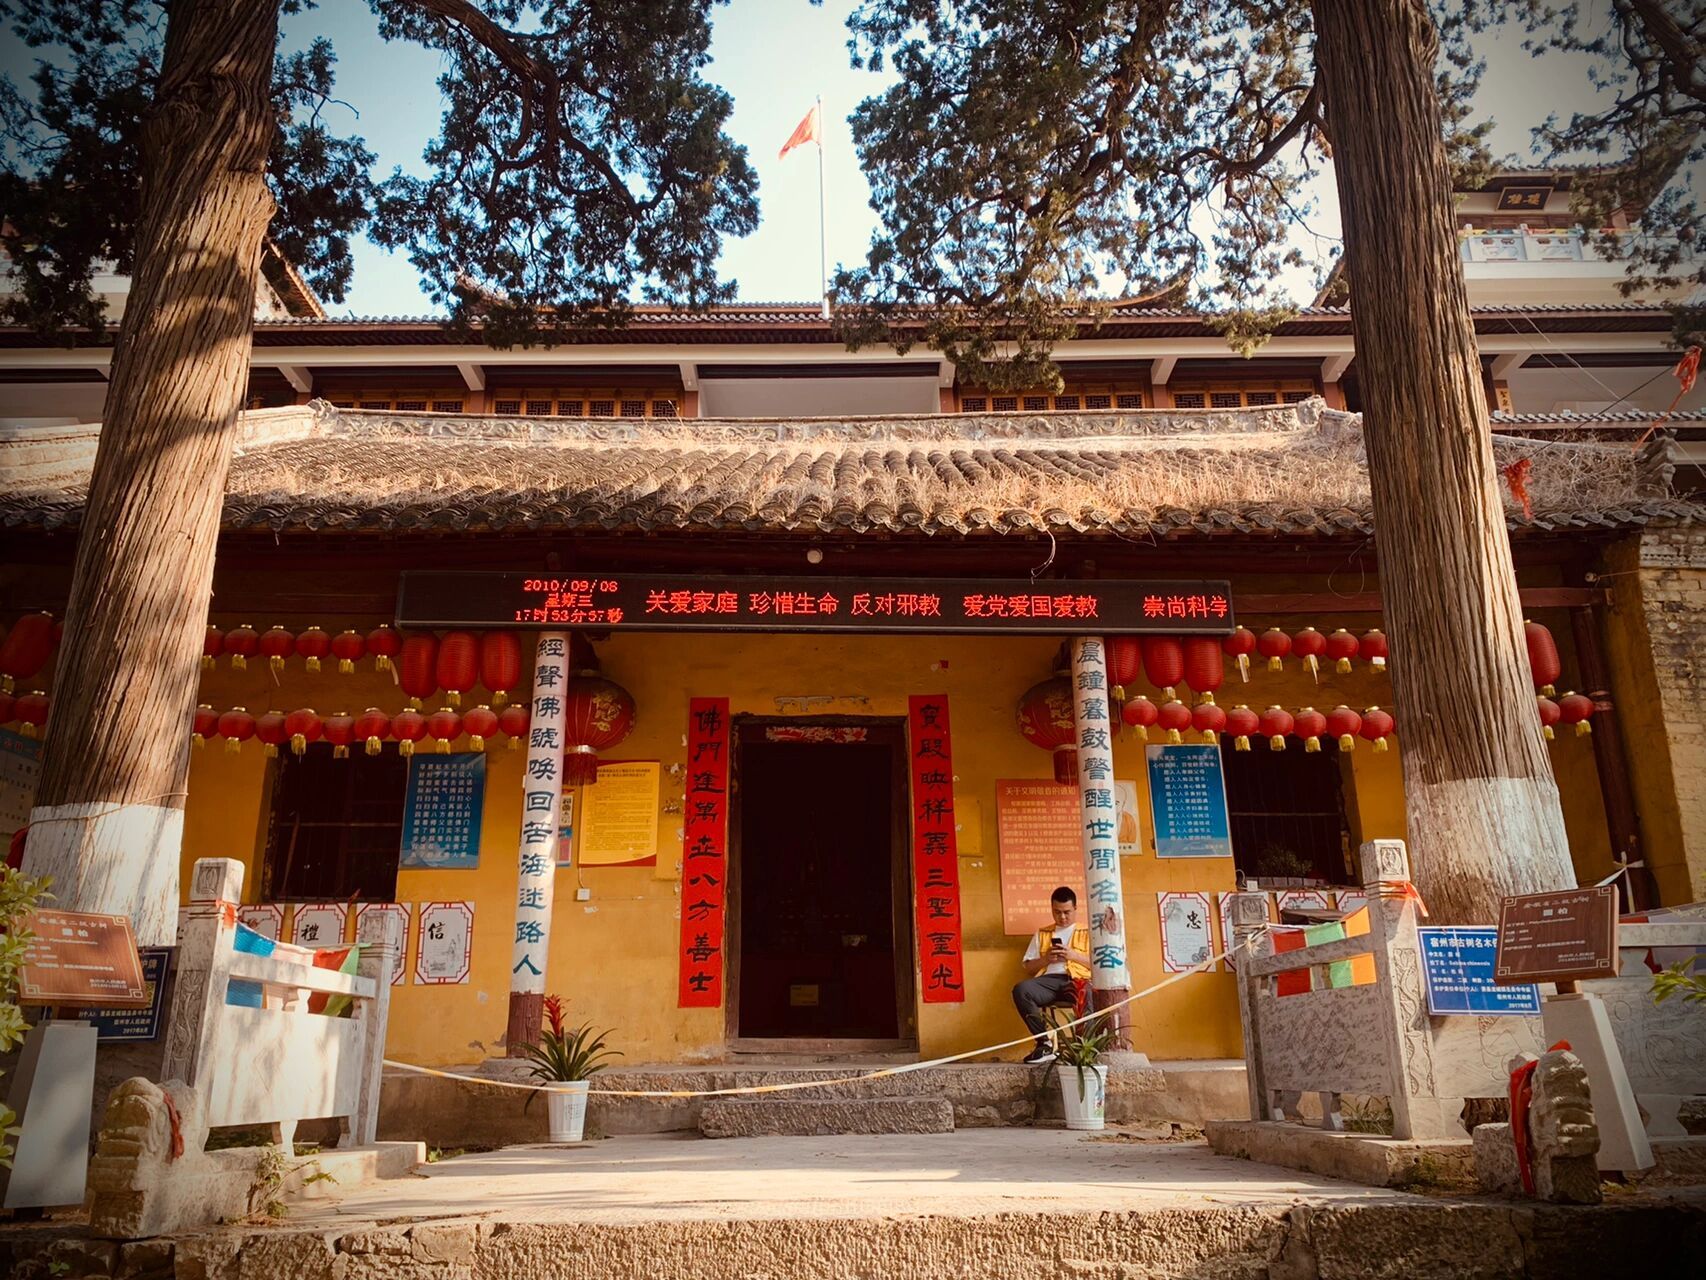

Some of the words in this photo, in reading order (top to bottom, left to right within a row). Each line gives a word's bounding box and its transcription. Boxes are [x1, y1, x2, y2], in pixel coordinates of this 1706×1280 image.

[545, 593, 593, 607] 星期三
[646, 590, 738, 613] 关爱家庭
[749, 592, 839, 615] 珍惜生命
[851, 593, 941, 616] 反对邪教
[963, 595, 1099, 618] 爱党爱国爱教
[1142, 596, 1228, 619] 崇尚科学
[1186, 911, 1202, 930] 忠
[428, 922, 446, 940] 信
